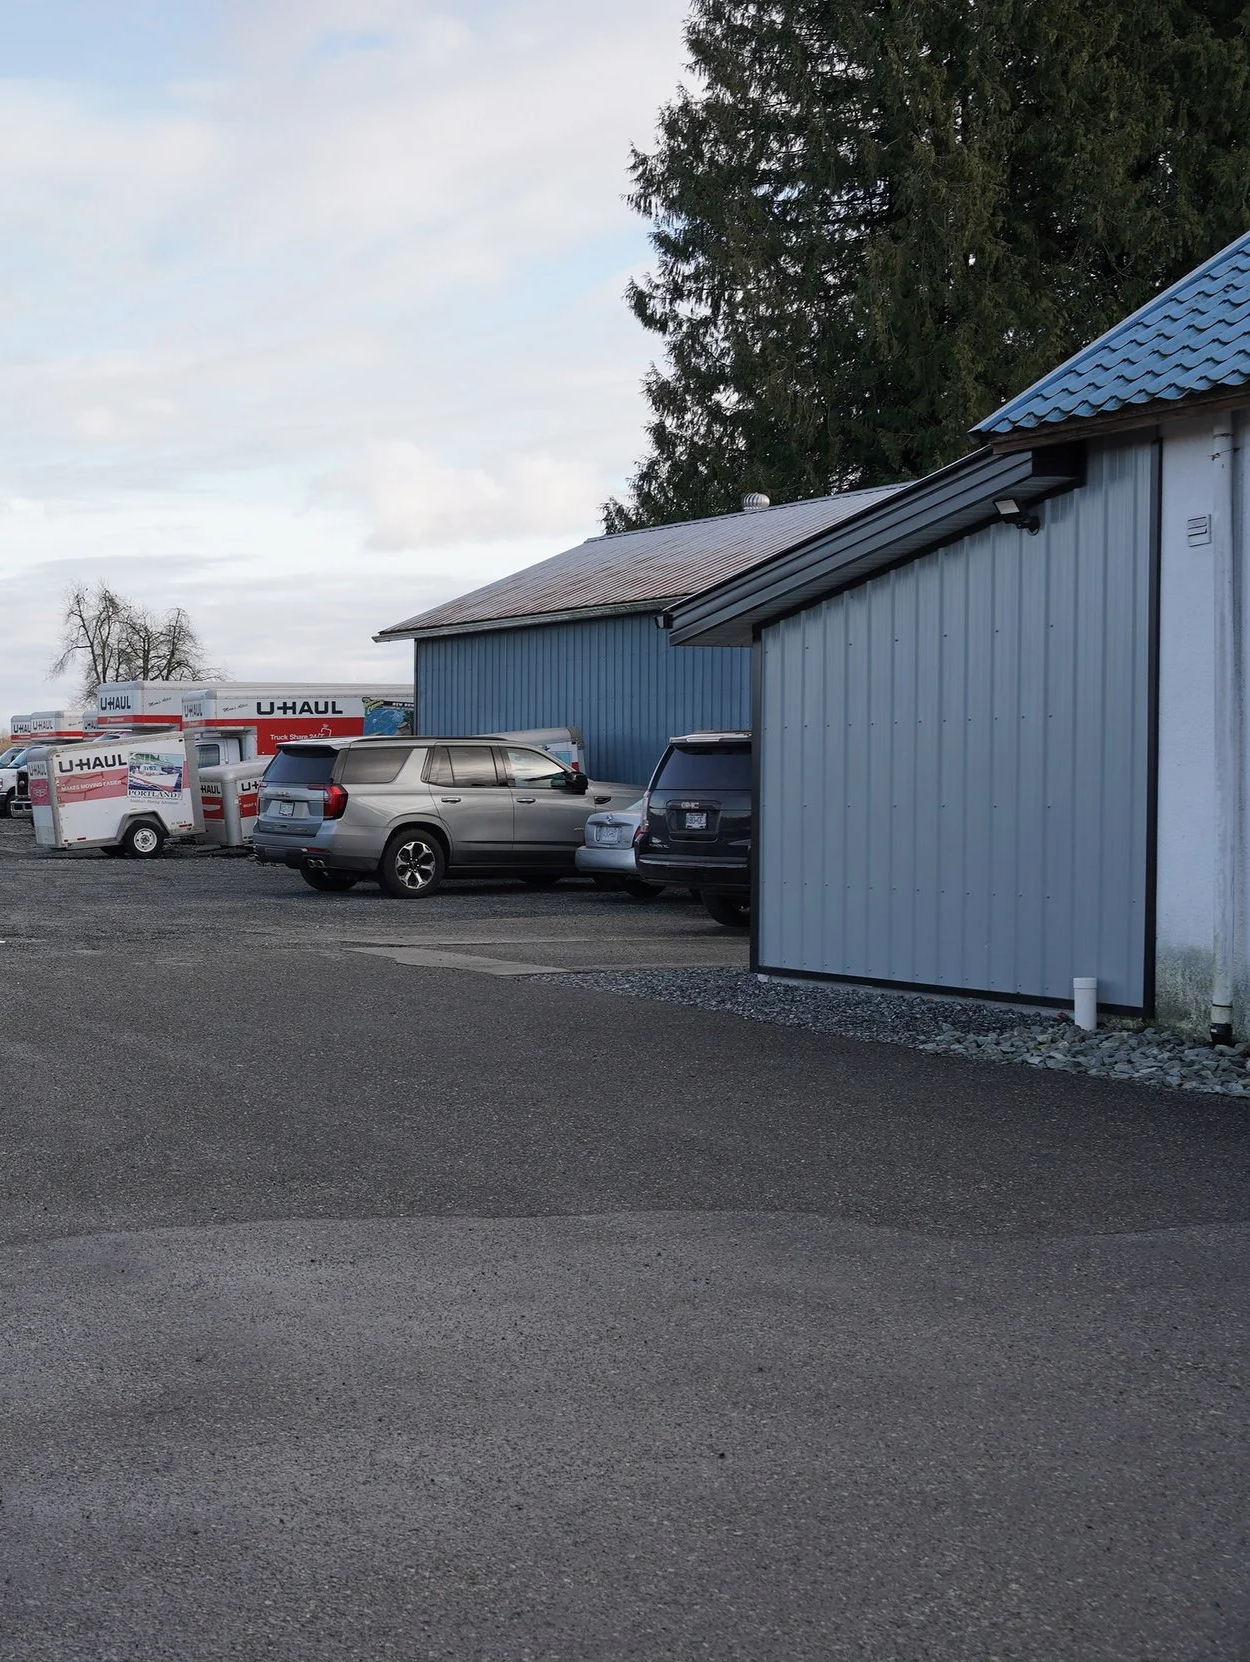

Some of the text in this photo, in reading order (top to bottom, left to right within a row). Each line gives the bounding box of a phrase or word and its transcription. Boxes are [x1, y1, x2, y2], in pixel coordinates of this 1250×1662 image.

[100, 696, 131, 710] U-HAUL
[256, 701, 342, 715] U-HAUL
[33, 720, 53, 730] U-HAUL
[59, 754, 127, 773] U-HAUL
